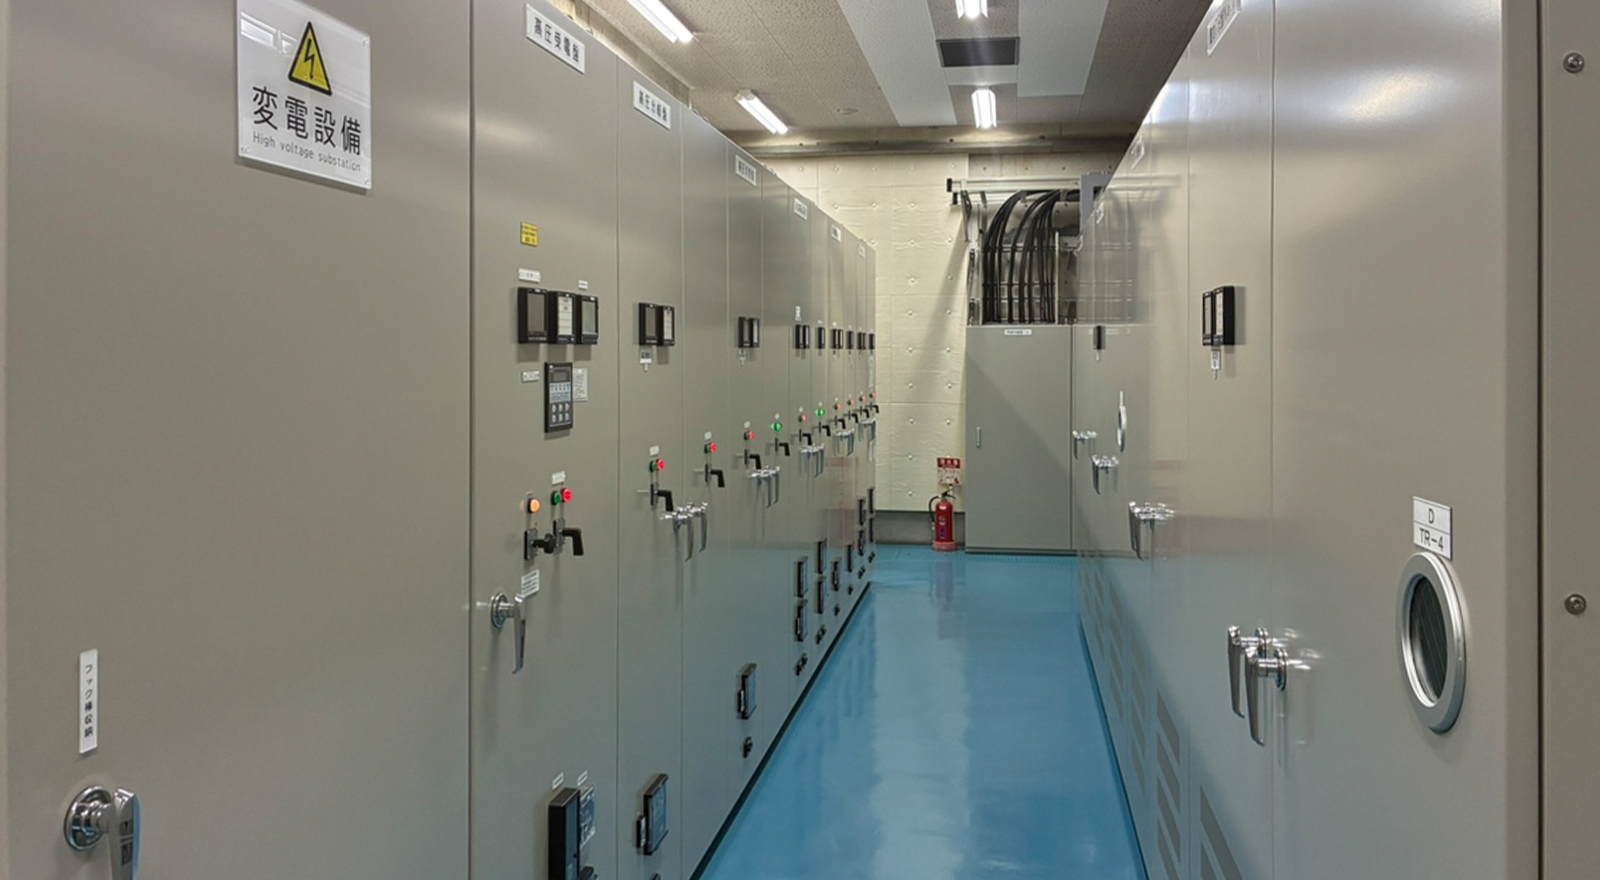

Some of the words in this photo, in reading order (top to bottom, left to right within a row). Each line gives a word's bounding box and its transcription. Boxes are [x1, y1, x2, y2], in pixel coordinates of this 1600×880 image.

[252, 86, 362, 156] 変電設備
[253, 131, 276, 149] High
[280, 141, 315, 160] voltage
[318, 150, 361, 172] substation
[1428, 507, 1435, 524] D
[1419, 526, 1444, 552] TR-4
